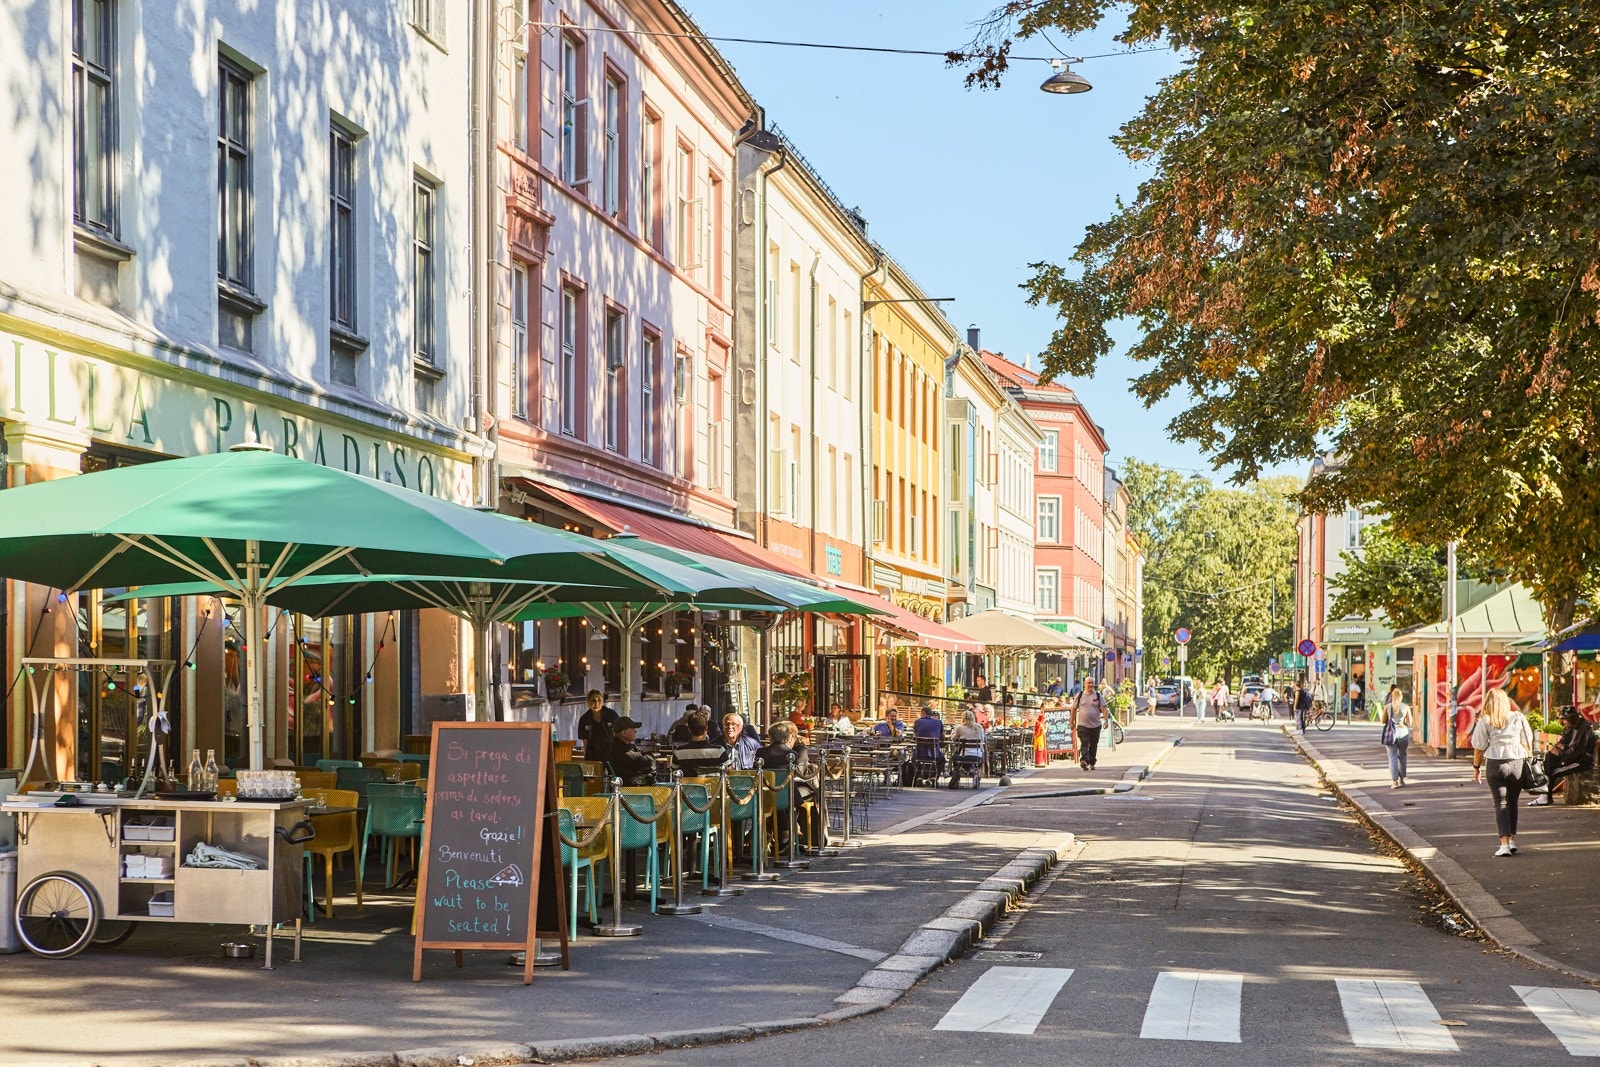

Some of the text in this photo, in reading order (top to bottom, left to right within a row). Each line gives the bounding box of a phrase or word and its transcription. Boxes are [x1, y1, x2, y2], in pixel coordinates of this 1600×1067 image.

[1095, 629, 1103, 640] 7
[446, 741, 531, 772] Si prega di
[448, 771, 509, 787] aspettare
[434, 789, 521, 806] prima di sedersi
[451, 810, 463, 820] ai
[439, 844, 503, 863] Benvenuti
[445, 868, 495, 890] Please
[433, 894, 509, 912] wait to be
